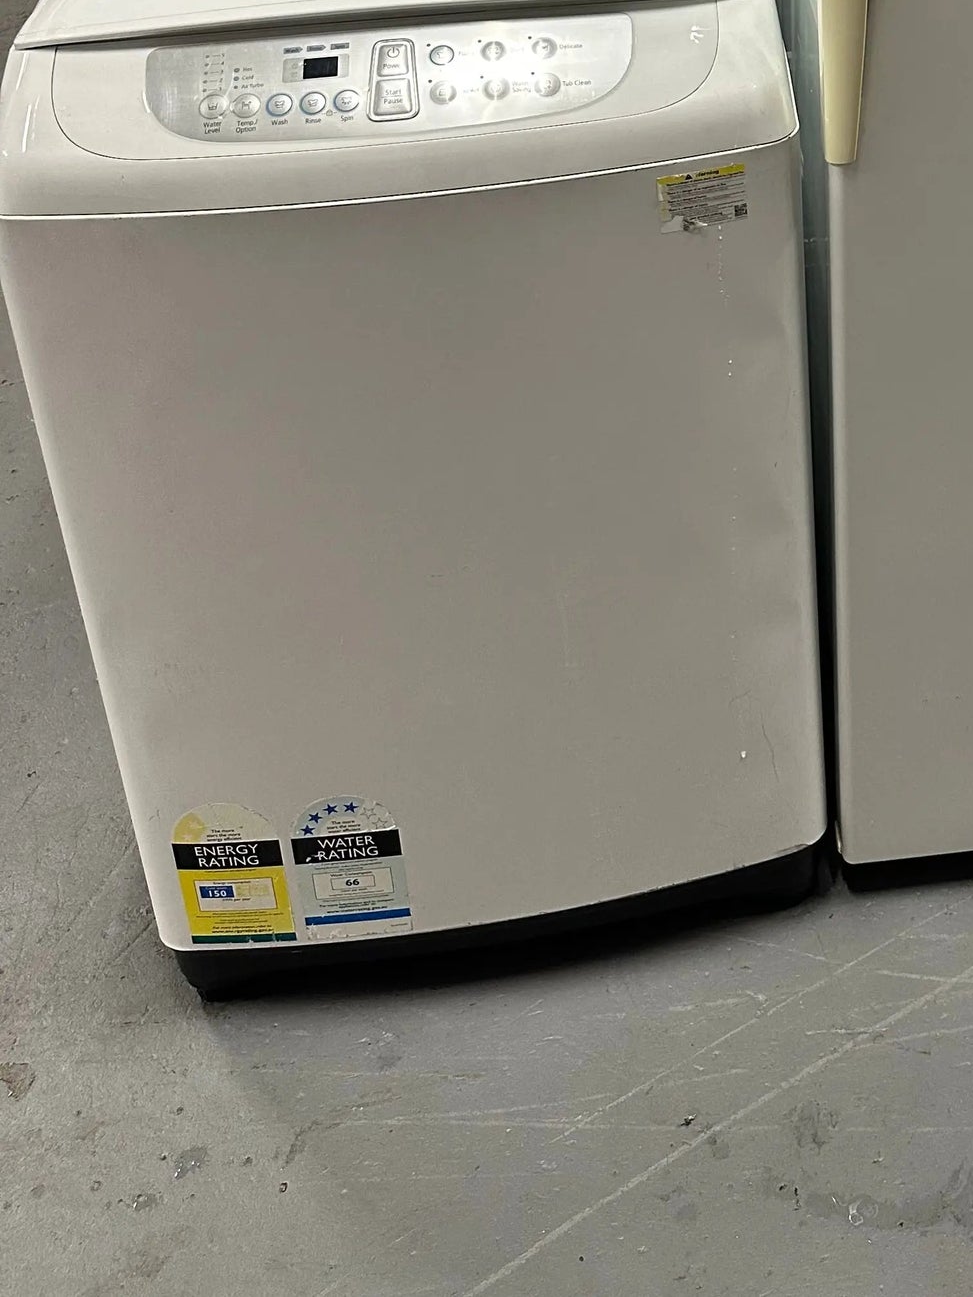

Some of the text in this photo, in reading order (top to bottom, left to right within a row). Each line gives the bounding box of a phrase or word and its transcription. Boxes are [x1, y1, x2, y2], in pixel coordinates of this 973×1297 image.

[204, 127, 221, 135] Level
[317, 835, 376, 849] WATER
[194, 843, 259, 856] ENERGY
[318, 845, 379, 861] RATING
[198, 855, 260, 868] RATING
[345, 878, 360, 887] 66
[208, 890, 227, 898] 150
